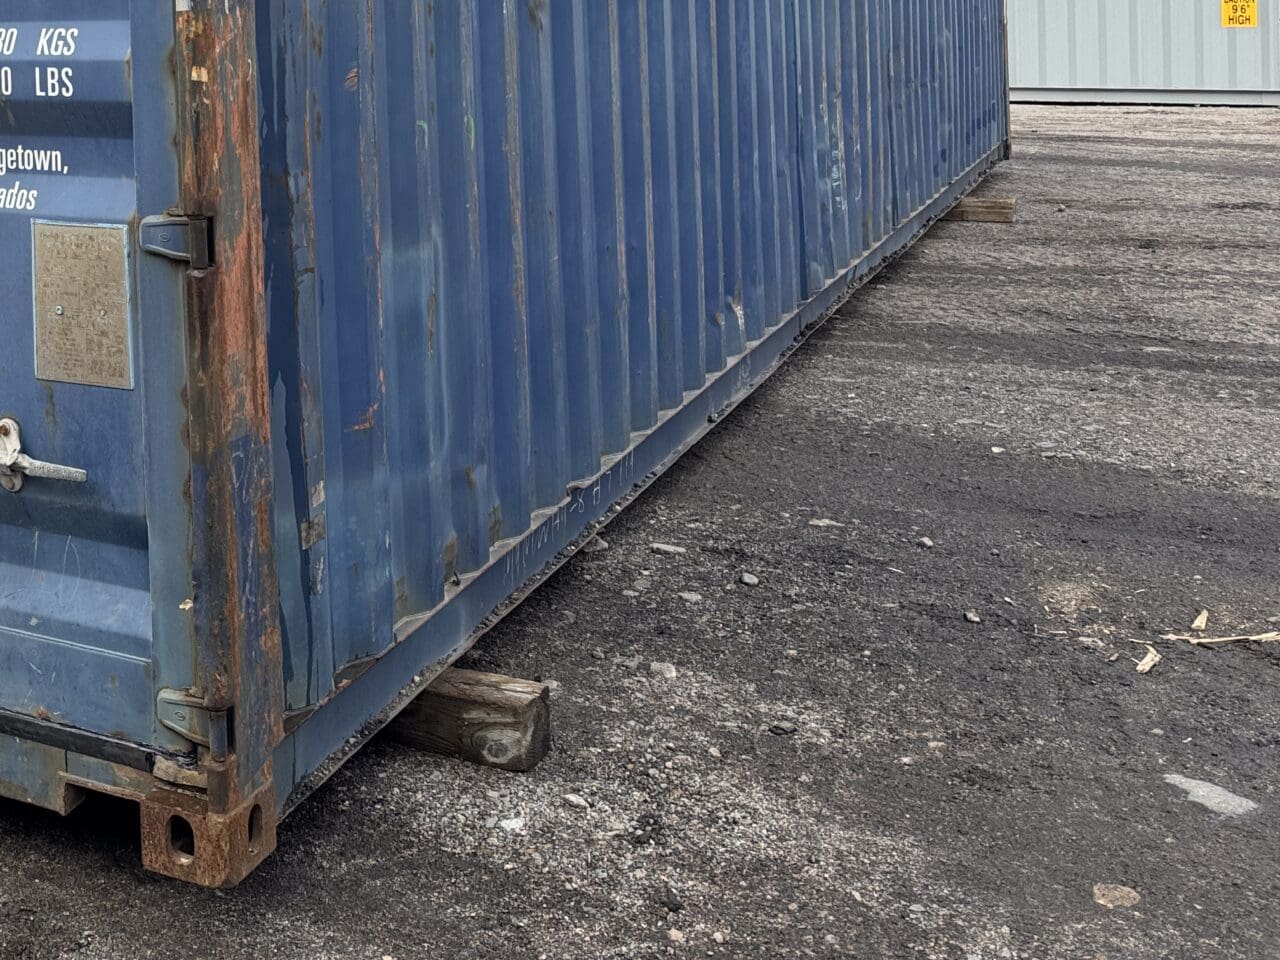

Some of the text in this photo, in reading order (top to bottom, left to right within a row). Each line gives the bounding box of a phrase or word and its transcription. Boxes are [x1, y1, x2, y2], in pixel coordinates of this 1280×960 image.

[1228, 15, 1250, 24] HIGH
[36, 28, 78, 56] KGS
[35, 67, 74, 96] LBS
